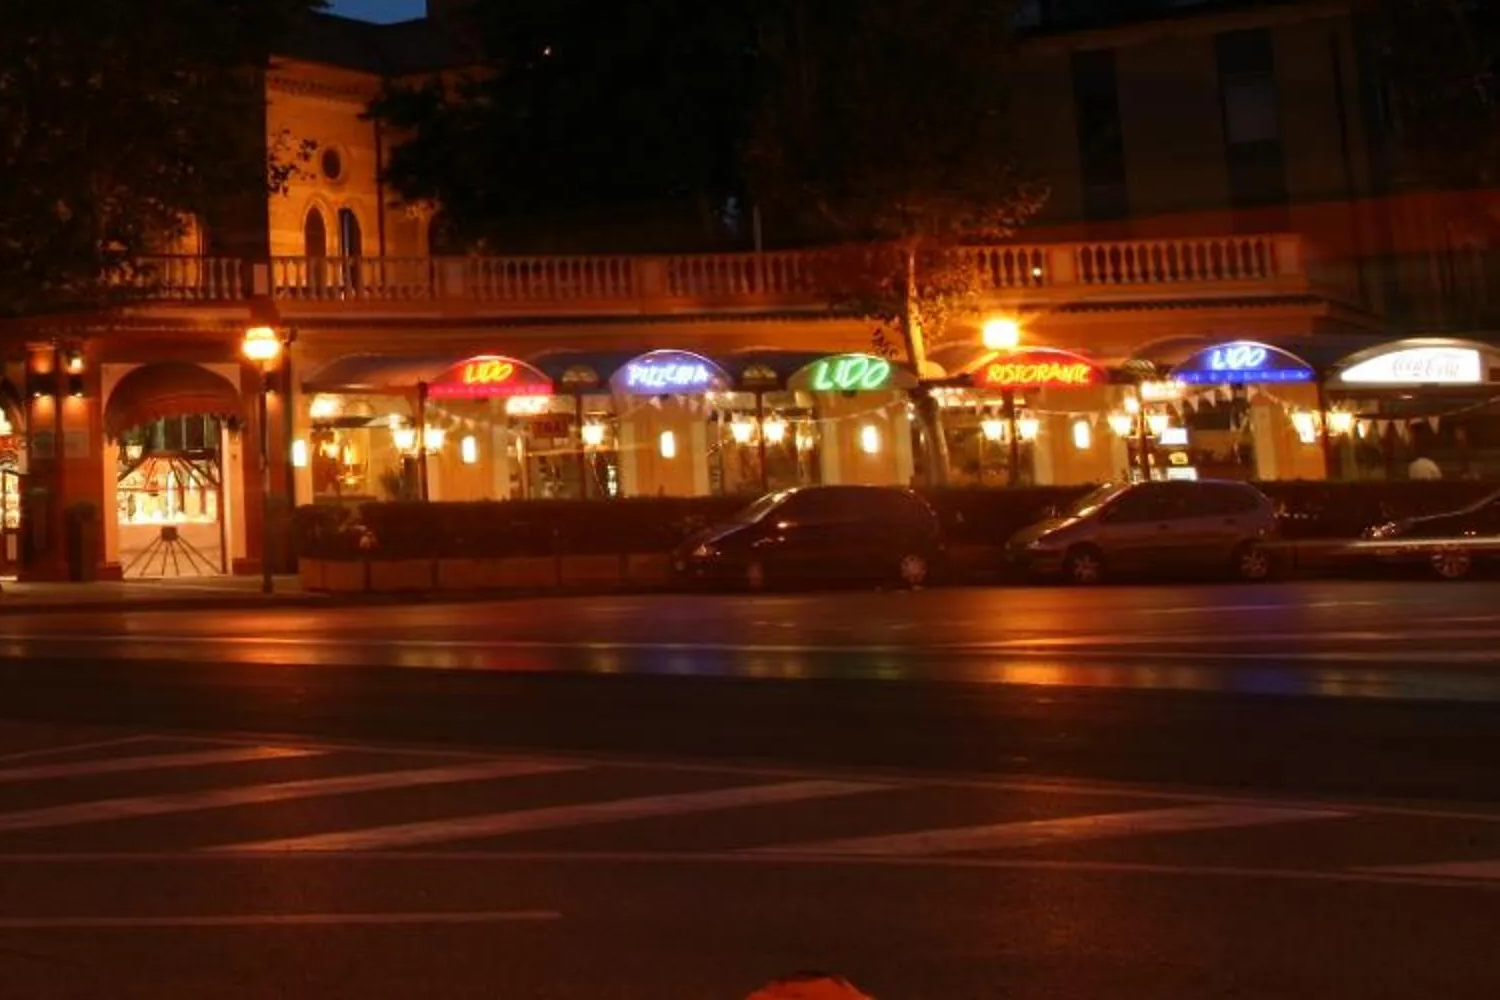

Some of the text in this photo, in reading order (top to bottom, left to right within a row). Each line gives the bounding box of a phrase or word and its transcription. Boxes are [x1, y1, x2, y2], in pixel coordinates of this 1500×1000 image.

[1211, 346, 1267, 371] LIDO
[463, 360, 513, 384] LIDO
[815, 357, 890, 390] LIDO
[986, 363, 1091, 384] RISTORANTE
